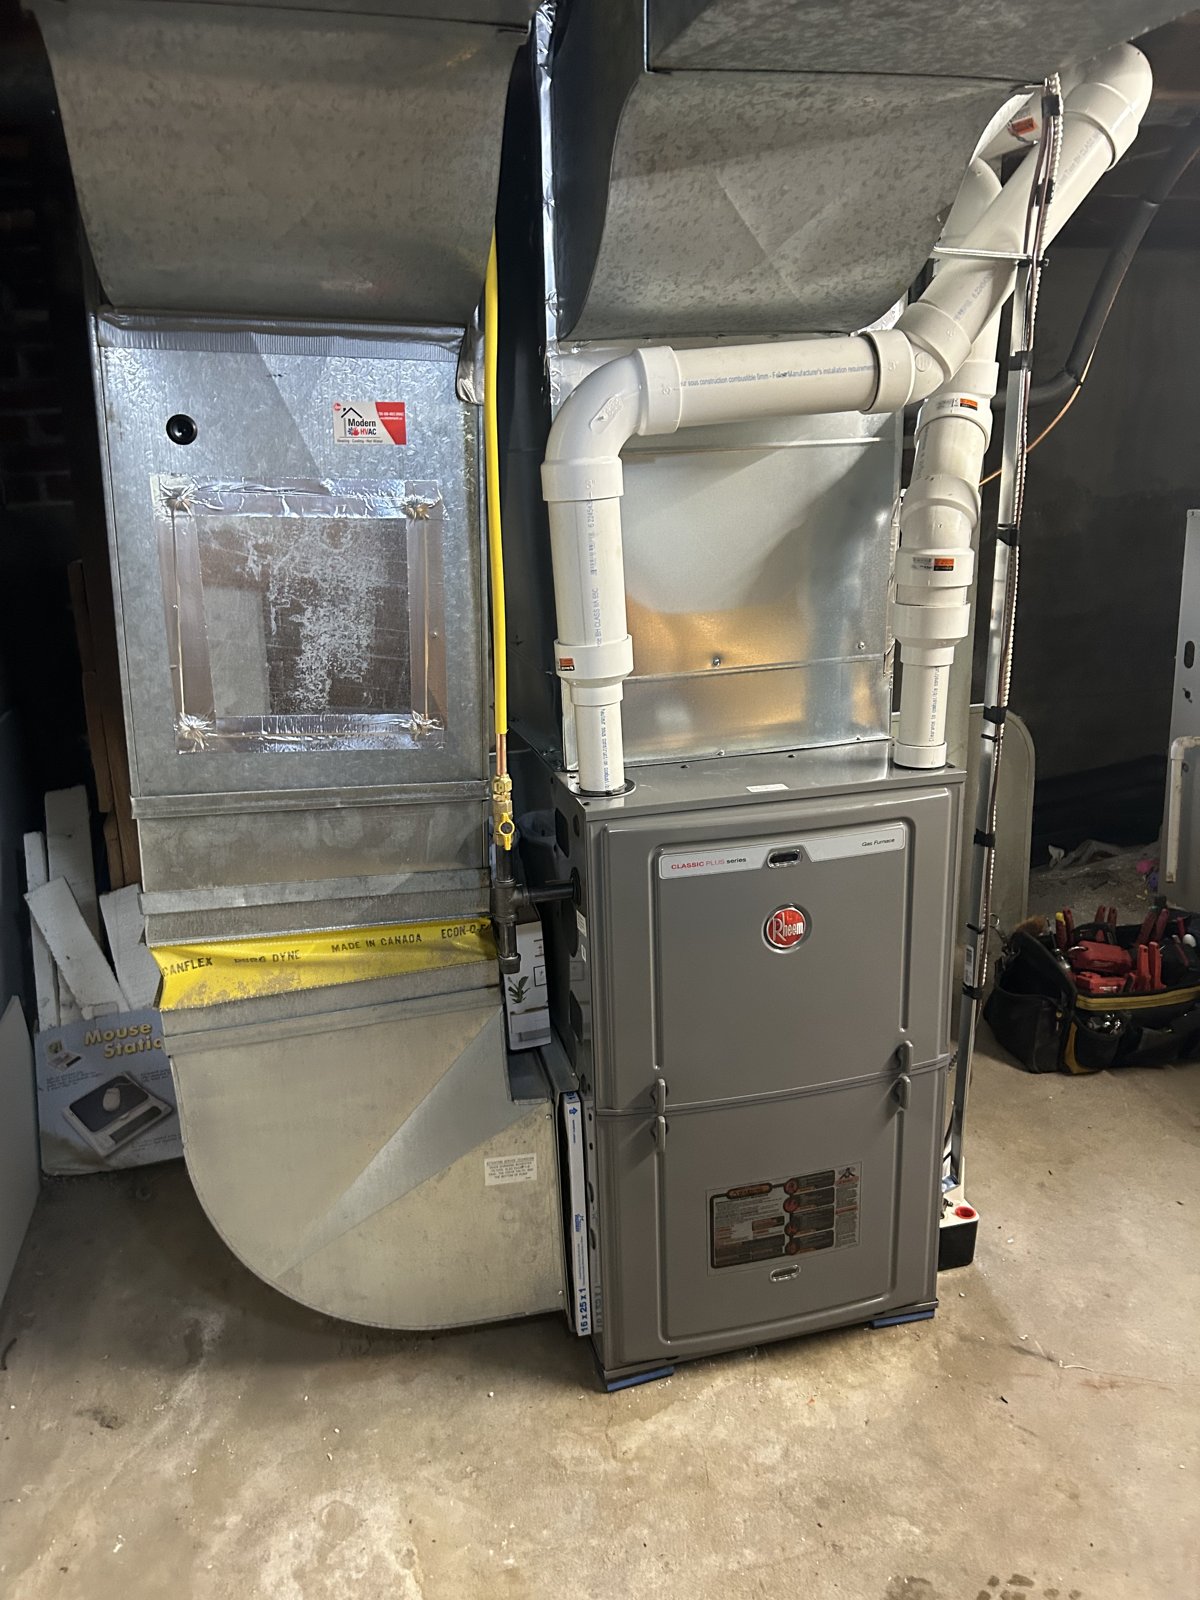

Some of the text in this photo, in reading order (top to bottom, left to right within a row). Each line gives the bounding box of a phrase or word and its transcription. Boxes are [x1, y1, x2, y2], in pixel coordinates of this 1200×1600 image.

[348, 418, 376, 427] Modern
[593, 608, 601, 628] CLASS
[874, 838, 895, 846] Furnace
[671, 861, 704, 870] CLASSIC
[705, 858, 725, 866] PLUS
[772, 912, 804, 941] Rheem
[162, 956, 213, 977] CANFLEX
[272, 949, 301, 963] DYNE
[331, 941, 361, 953] MADE
[365, 939, 375, 947] IN
[380, 933, 422, 946] CANADA
[84, 1023, 152, 1046] Mouse
[104, 1035, 162, 1059] Statio
[579, 1302, 587, 1312] 25
[580, 1321, 588, 1332] 16
